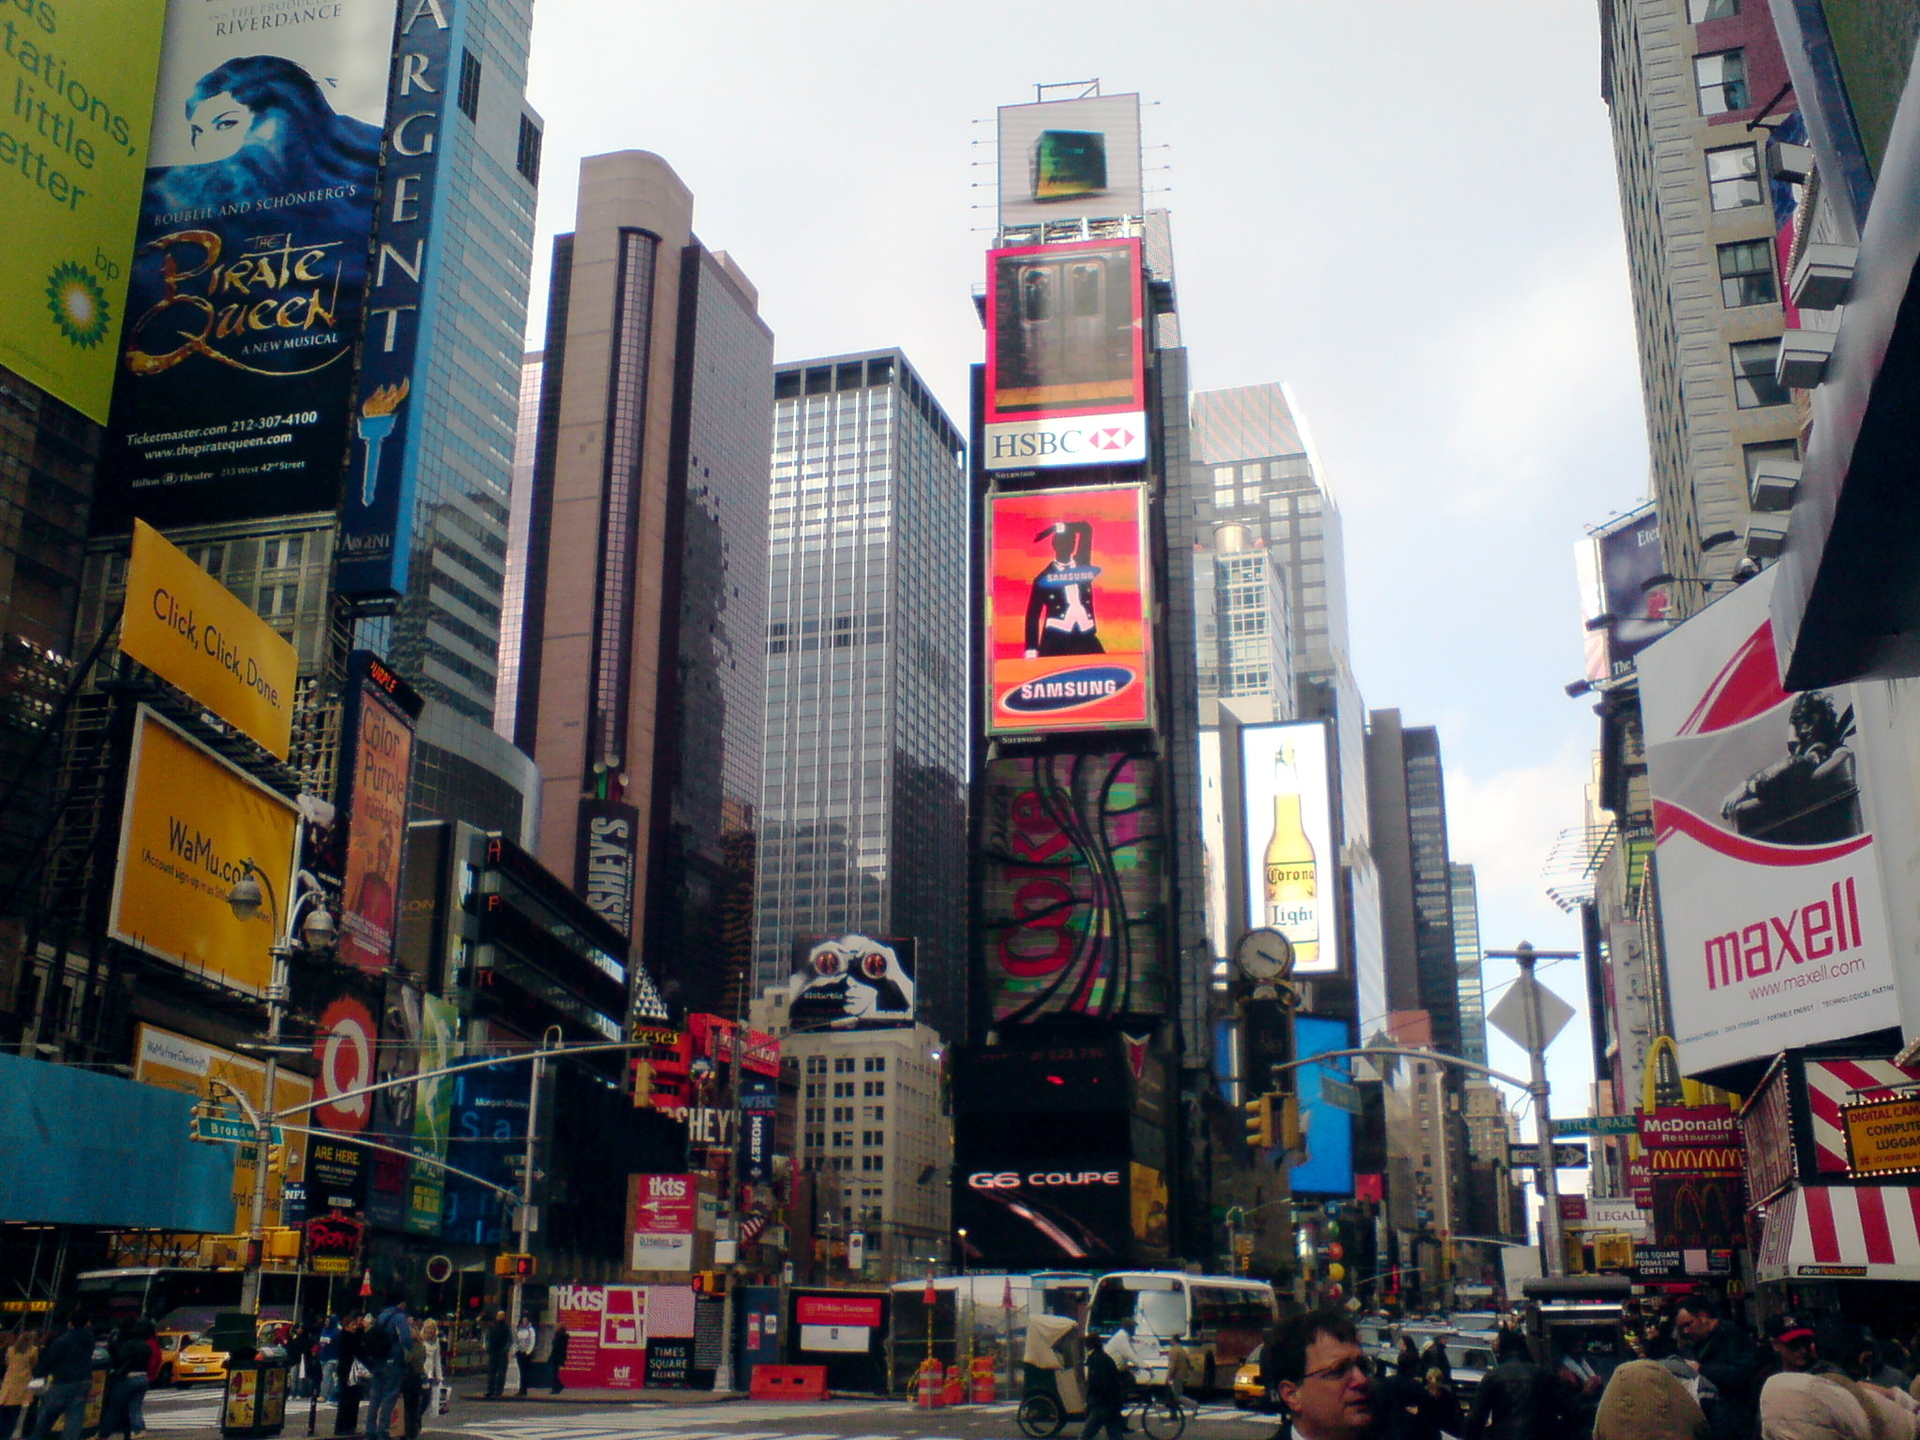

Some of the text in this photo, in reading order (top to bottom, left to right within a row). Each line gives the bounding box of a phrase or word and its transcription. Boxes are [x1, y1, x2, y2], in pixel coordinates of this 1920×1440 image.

[216, 4, 341, 36] RIVERDANCE
[14, 77, 95, 169] little
[218, 201, 250, 217] AND
[94, 247, 120, 281] bp
[241, 332, 338, 355] A NEW MUSICAL
[126, 410, 318, 446] Ticketmaster.com 212-307-4100
[144, 433, 293, 460] www.thepiratequeen.com
[992, 429, 1082, 459] HSBC
[1047, 570, 1094, 582] SAMSUNG
[152, 587, 281, 710] Click, Click, Done.
[1613, 661, 1632, 676] The
[1021, 678, 1117, 700] SAMSUNG
[363, 707, 400, 760] Color
[363, 751, 404, 805] Purple
[169, 815, 252, 886] WaMu.co
[1266, 864, 1315, 886] Corona
[1272, 904, 1313, 926] Light
[1704, 876, 1862, 990] maxell
[1749, 957, 1865, 1001] www.maxell.com
[322, 1018, 370, 1119] Q
[1644, 1118, 1743, 1132] McDonald's
[1850, 1108, 1892, 1123] DIGITAL
[211, 1122, 256, 1138] Broadw
[751, 1115, 762, 1163] MORE?
[1662, 1133, 1729, 1142] Restaurant
[314, 1145, 361, 1165] ARE HERE.
[649, 1175, 687, 1196] tkts
[968, 1172, 1120, 1188] G6 COUPE
[285, 1189, 307, 1200] NFL
[1651, 1250, 1681, 1259] SQUARE
[1639, 1267, 1669, 1275] CENTER
[557, 1284, 603, 1312] tkts
[653, 1346, 687, 1358] TIMES
[613, 1365, 631, 1380] tdf
[649, 1358, 688, 1370] SQUARE
[650, 1370, 687, 1379] ALLIANCE
